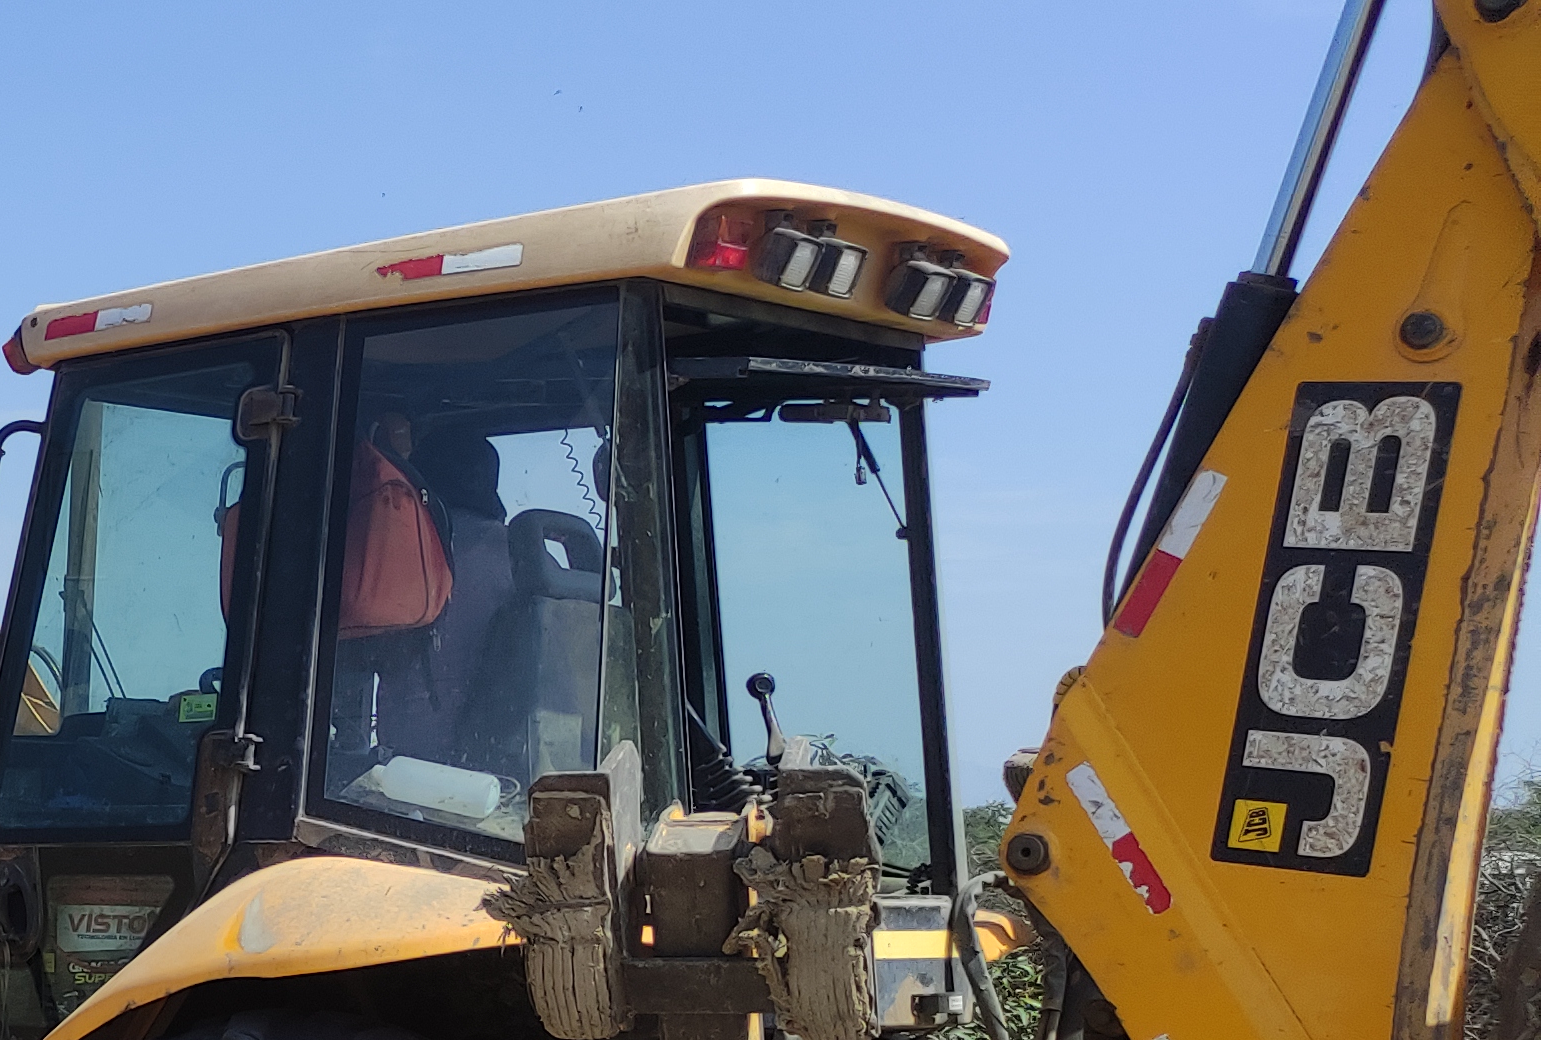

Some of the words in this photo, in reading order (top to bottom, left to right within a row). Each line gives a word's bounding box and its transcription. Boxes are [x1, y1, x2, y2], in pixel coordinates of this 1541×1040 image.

[1242, 396, 1436, 857] JCB
[1241, 809, 1269, 837] JCB
[68, 912, 152, 934] VISTO
